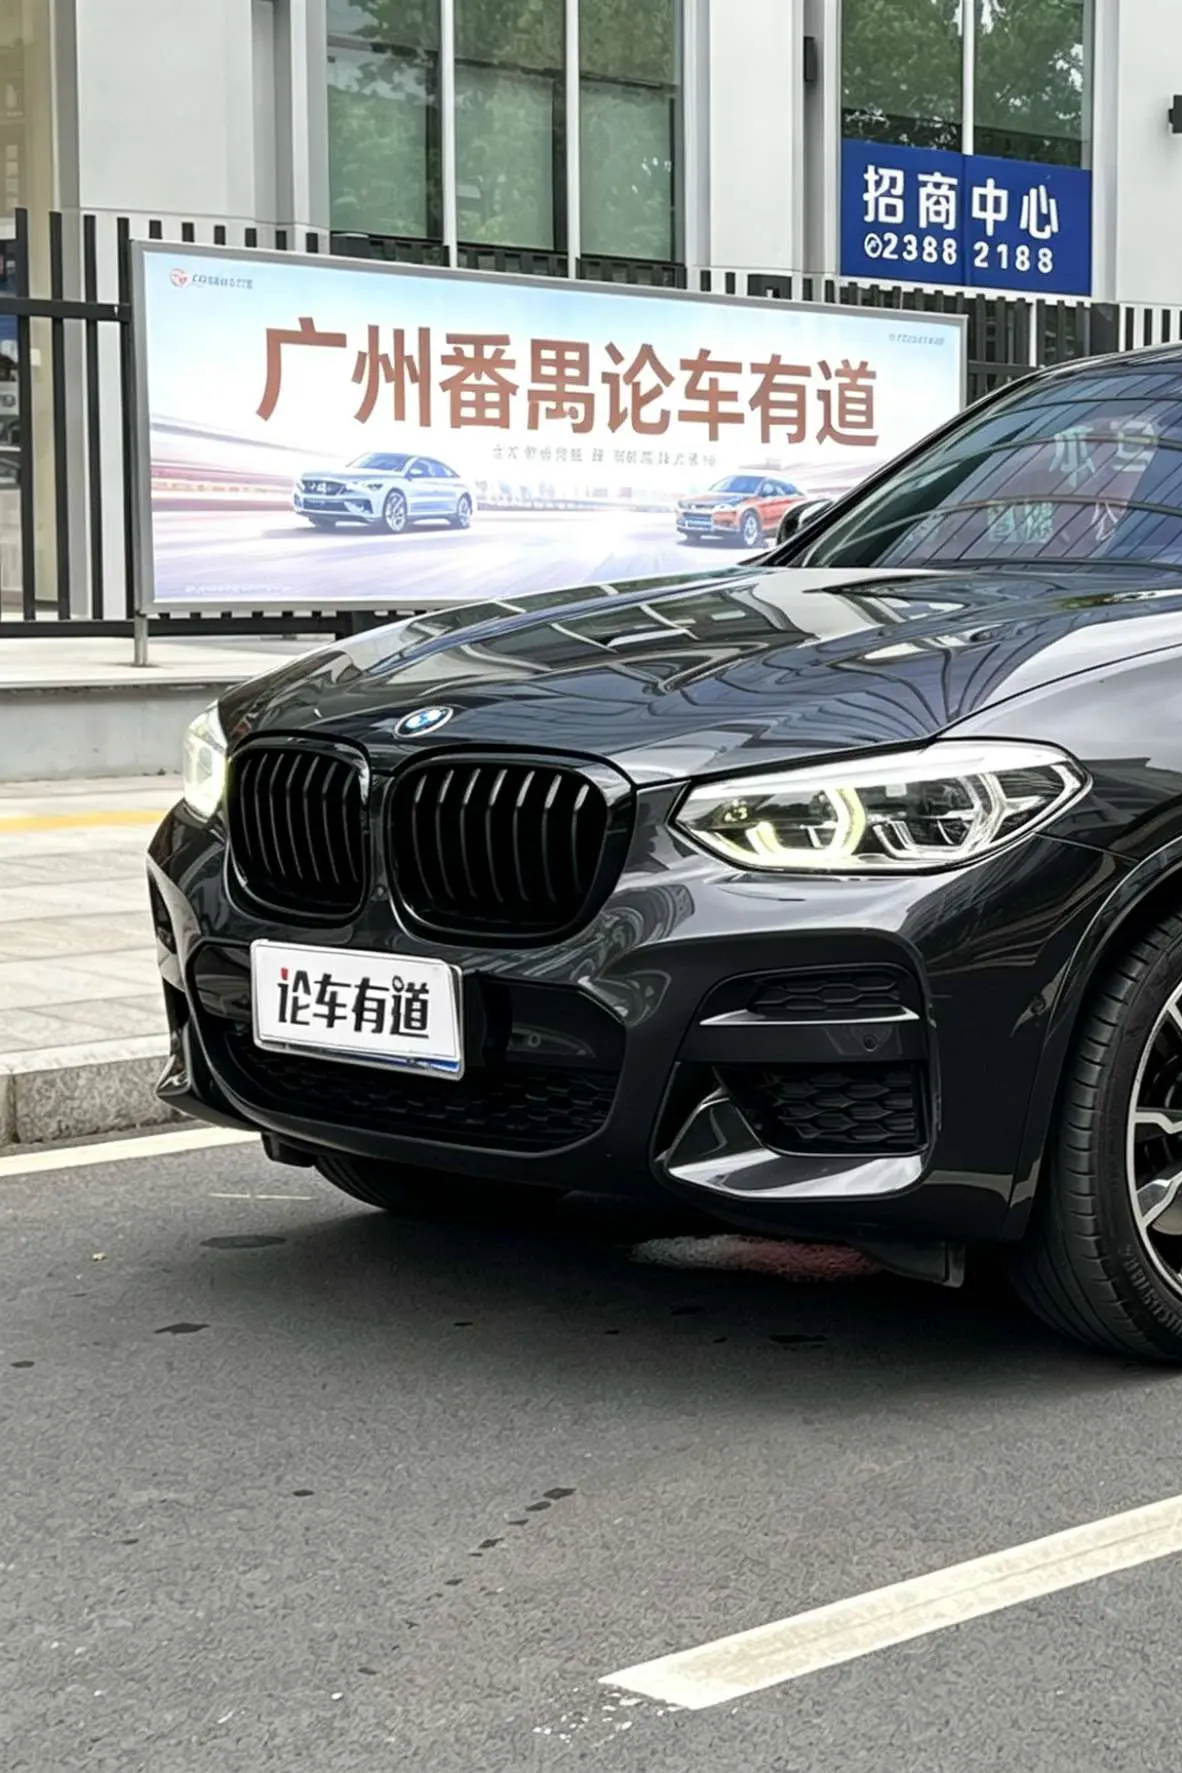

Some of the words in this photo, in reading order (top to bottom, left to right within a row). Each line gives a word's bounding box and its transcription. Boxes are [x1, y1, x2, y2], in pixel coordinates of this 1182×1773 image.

[863, 164, 1060, 240] 招商中心
[882, 232, 958, 265] 2388
[973, 241, 1054, 274] 2188
[256, 316, 880, 447] 广州番禺论车有道
[277, 967, 430, 1039] 论车有道
